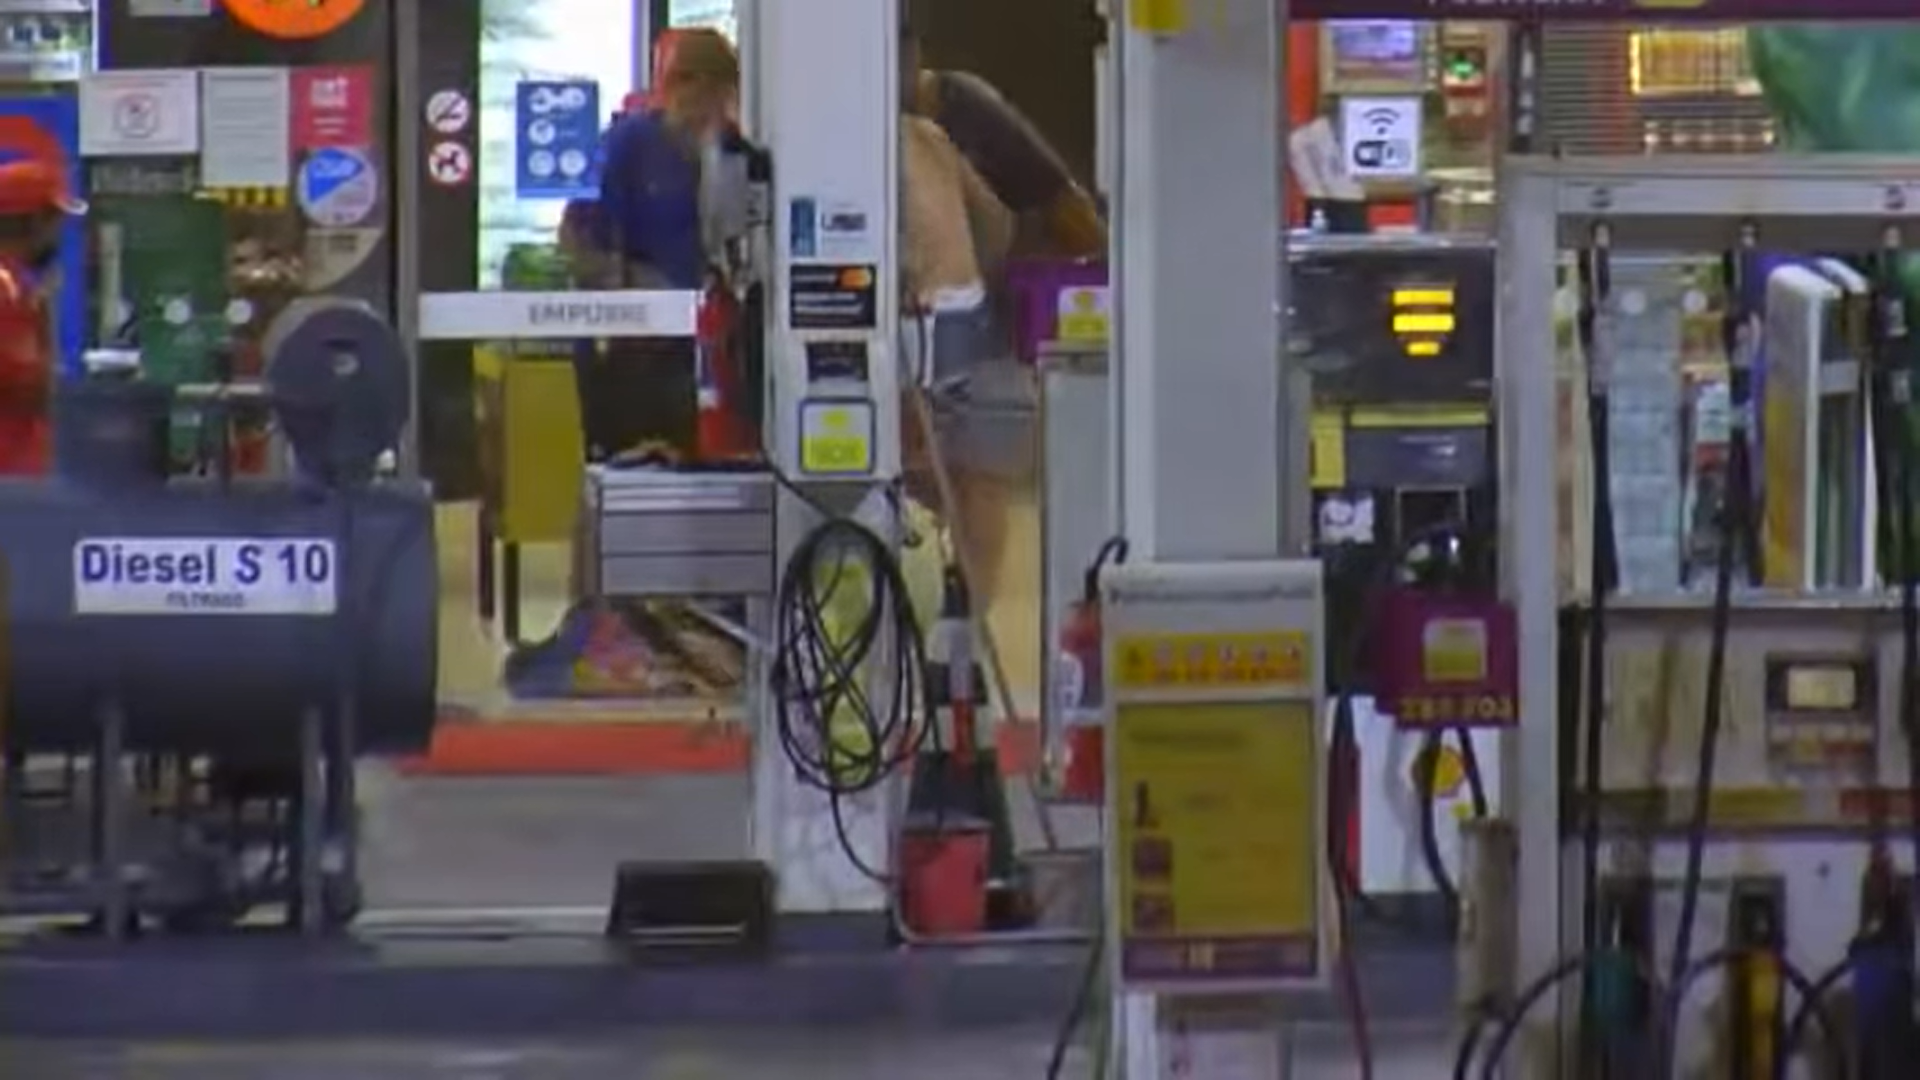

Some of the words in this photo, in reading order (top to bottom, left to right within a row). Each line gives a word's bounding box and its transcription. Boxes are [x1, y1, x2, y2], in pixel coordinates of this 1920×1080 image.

[82, 543, 216, 584] Diesel
[235, 544, 262, 584] S
[276, 543, 329, 584] 10
